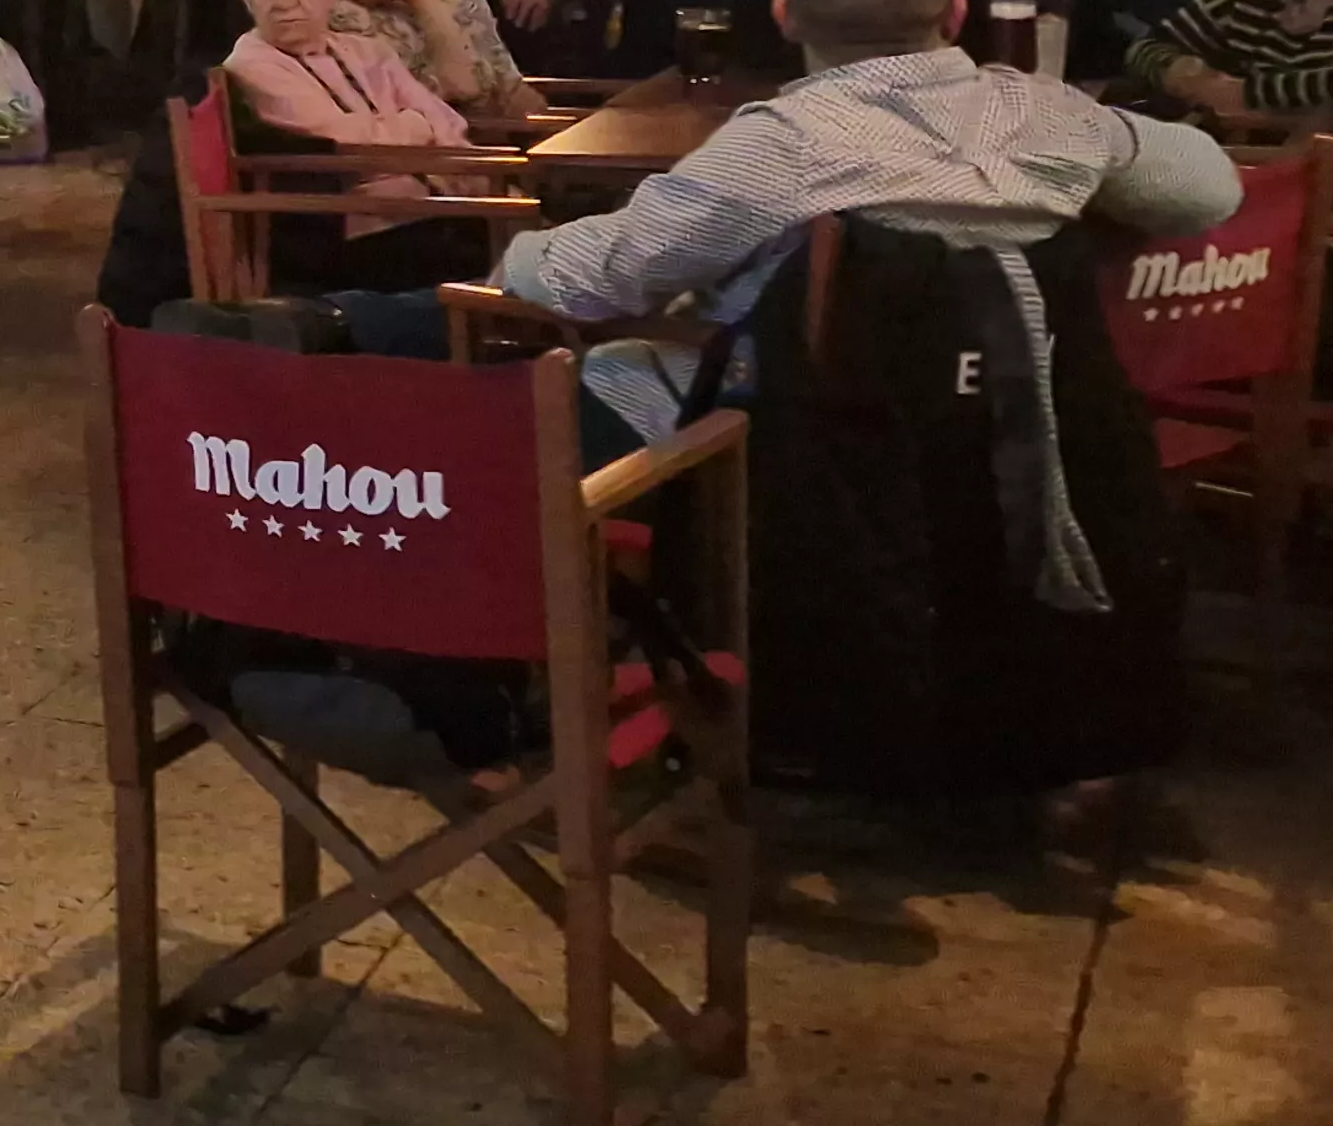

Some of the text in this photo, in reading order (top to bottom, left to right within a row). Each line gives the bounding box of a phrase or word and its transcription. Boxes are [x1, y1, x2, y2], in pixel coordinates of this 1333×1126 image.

[1126, 243, 1271, 300] Mahou
[957, 352, 982, 395] E
[186, 431, 452, 520] Mahou
